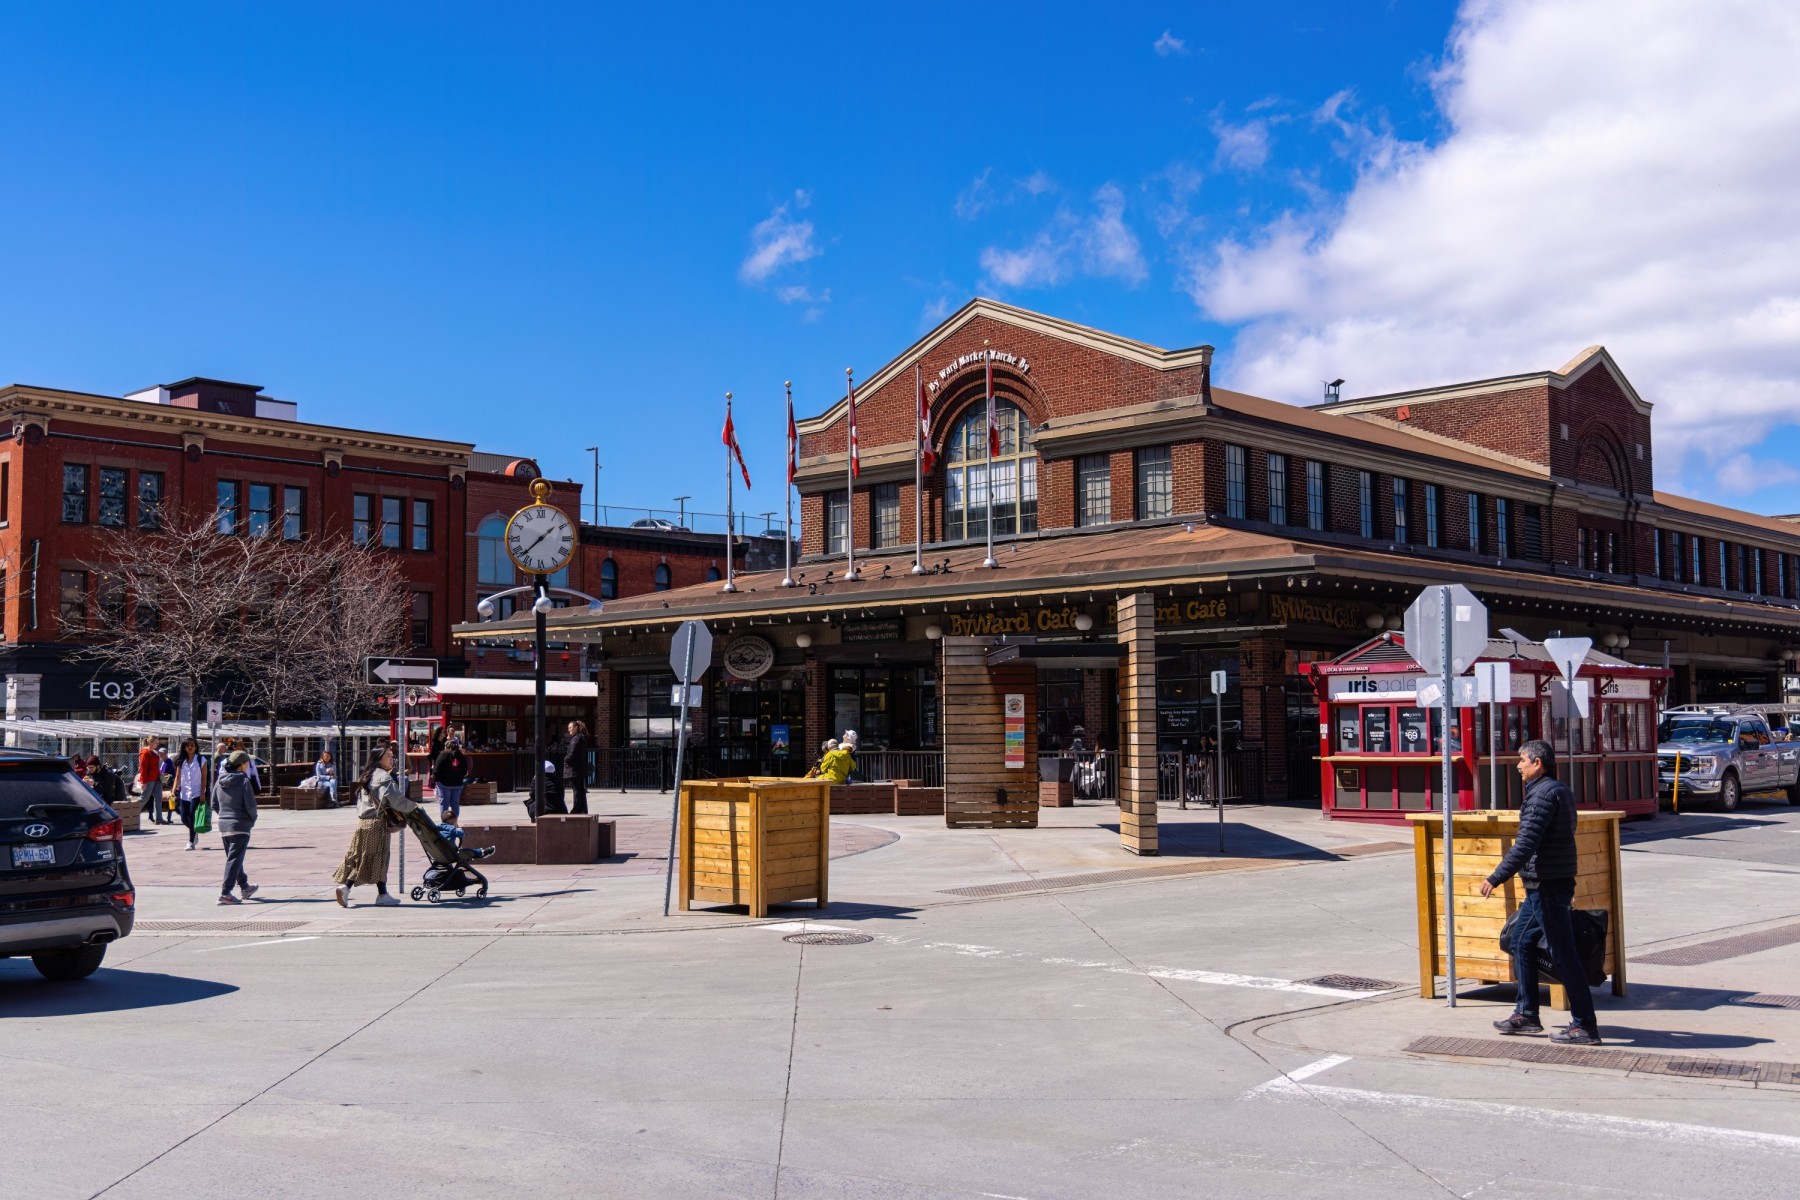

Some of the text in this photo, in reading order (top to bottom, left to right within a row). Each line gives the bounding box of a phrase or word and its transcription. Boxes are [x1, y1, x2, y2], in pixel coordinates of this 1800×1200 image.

[928, 379, 940, 392] By
[939, 360, 958, 379] Ward
[1019, 358, 1030, 373] By
[520, 465, 532, 477] 56
[536, 509, 546, 518] XII
[1186, 598, 1228, 620] Café
[1271, 593, 1334, 624] ByWard
[950, 606, 1080, 636] ByWard Café
[89, 682, 135, 700] EQ3
